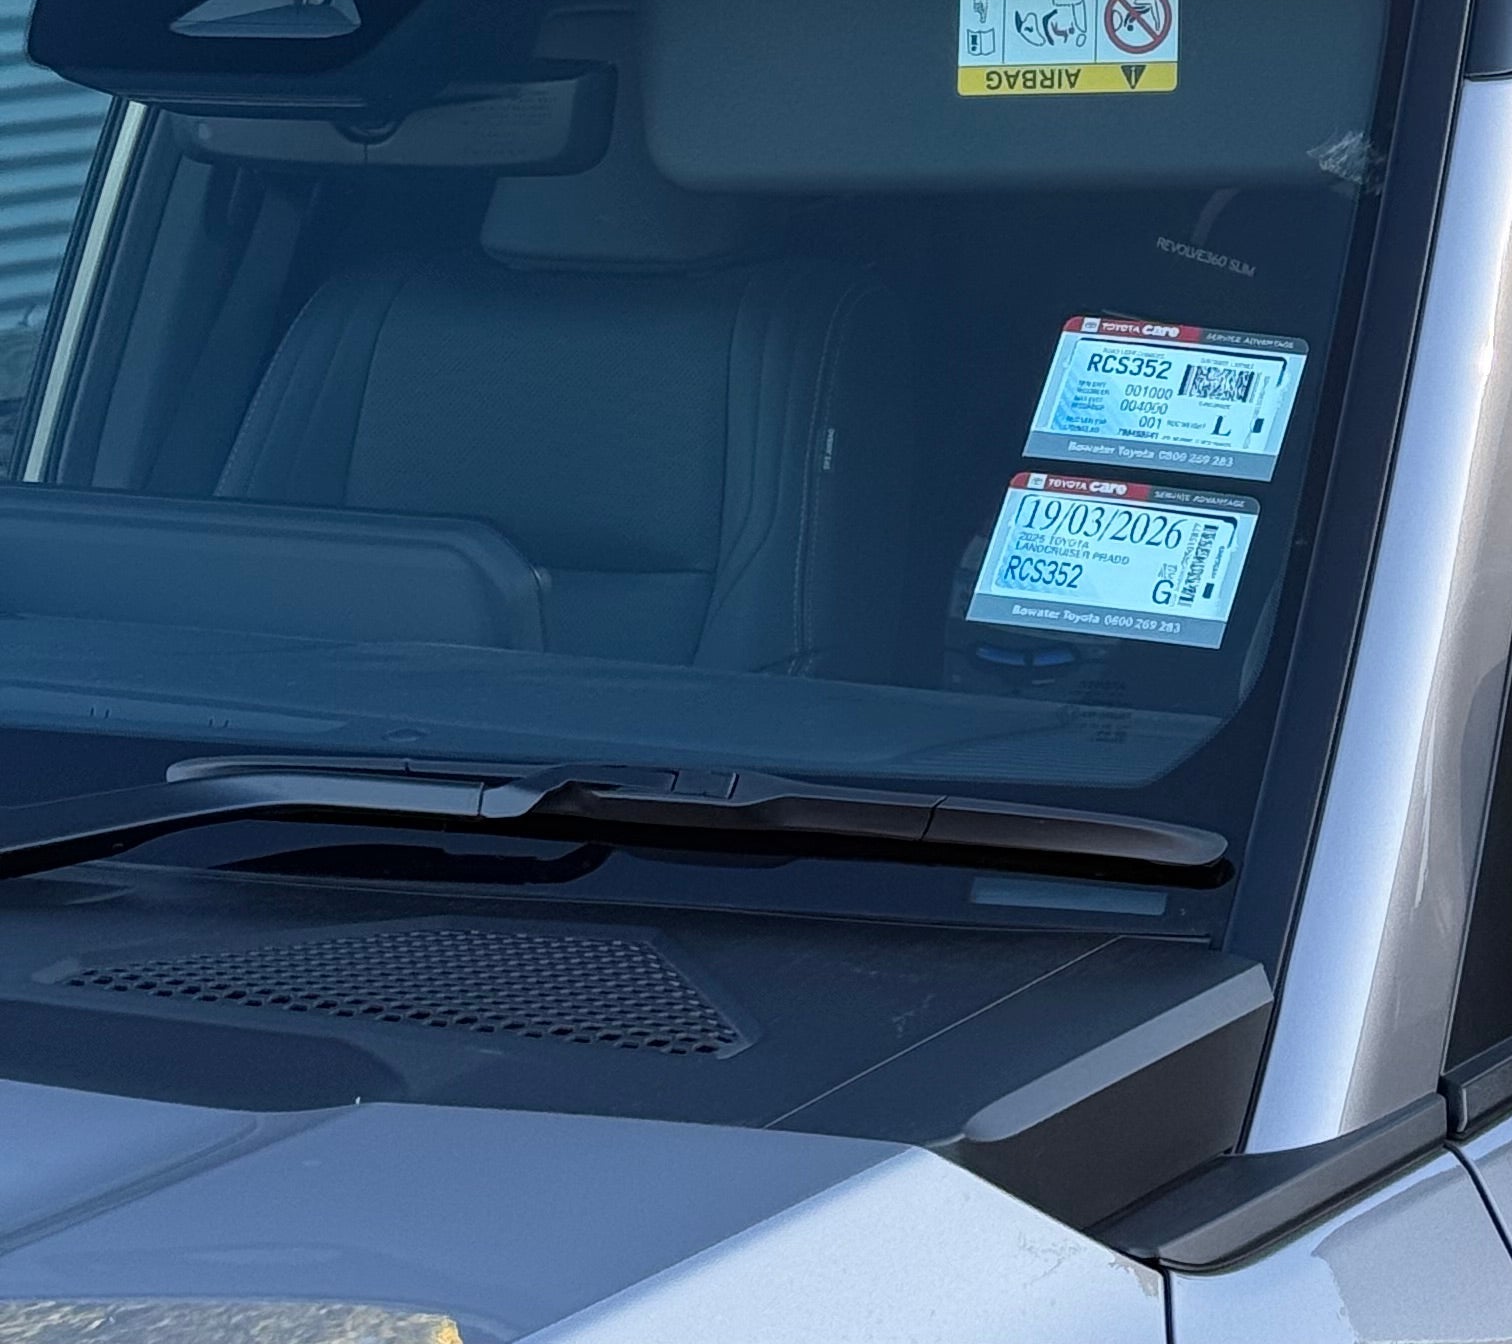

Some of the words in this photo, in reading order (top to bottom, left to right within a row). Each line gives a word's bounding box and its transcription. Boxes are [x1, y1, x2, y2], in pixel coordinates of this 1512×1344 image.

[985, 68, 1082, 90] AIRBAG
[1156, 236, 1228, 268] REVOLVE360
[1228, 259, 1257, 278] SLIM
[1101, 322, 1141, 334] TOYOTA
[1141, 324, 1180, 338] care
[1086, 353, 1173, 380] RCS352
[1124, 383, 1174, 401] 001000
[1138, 415, 1163, 429] 001
[1210, 415, 1232, 437] L
[1118, 445, 1154, 460] Toyota
[1048, 478, 1088, 491] TOYOTA
[1088, 481, 1128, 496] care
[1022, 498, 1189, 551] 19/03/2026
[1049, 533, 1090, 550] TOYOTA
[1014, 540, 1090, 560] LANDCRUISER
[1091, 551, 1131, 566] PRADO
[1003, 554, 1084, 589] RCS352
[1152, 578, 1175, 606] G
[1011, 604, 1060, 620] Bowater
[1063, 609, 1100, 624] Toyota
